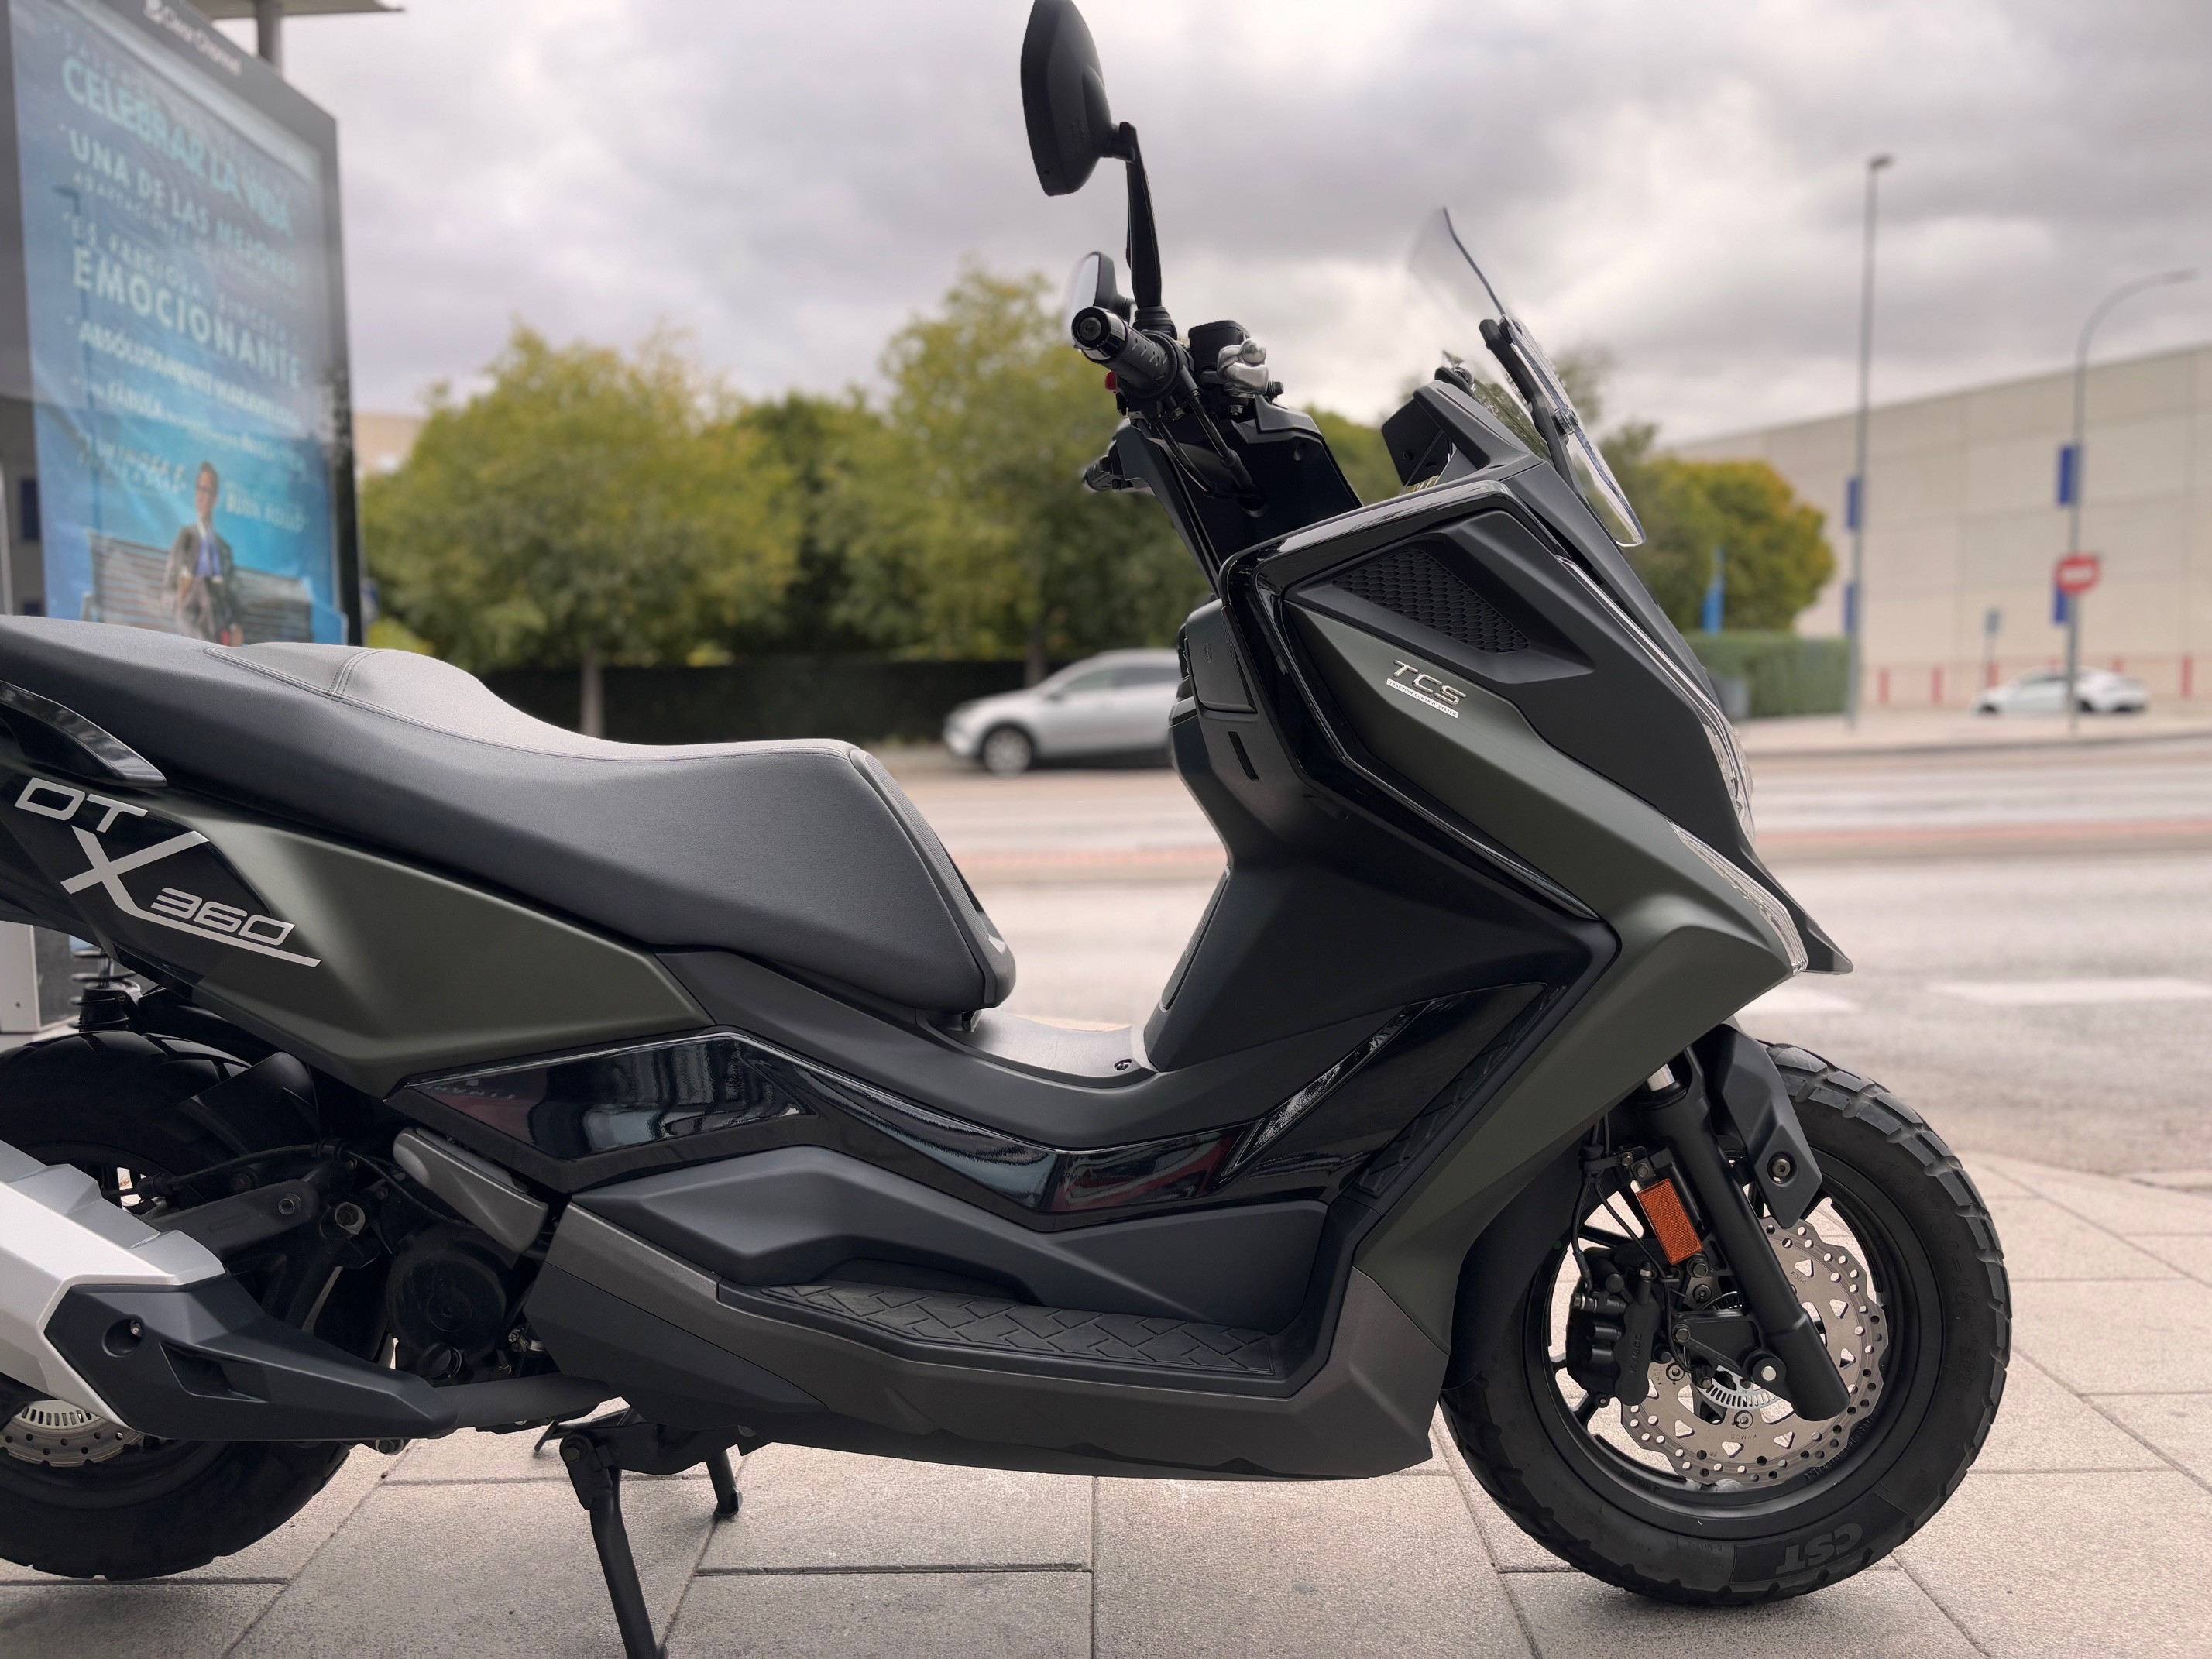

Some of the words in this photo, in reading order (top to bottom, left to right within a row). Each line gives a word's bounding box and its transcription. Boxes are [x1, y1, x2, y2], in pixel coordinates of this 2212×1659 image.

[61, 55, 207, 180] CELEBRAR
[209, 149, 242, 201] LA
[136, 167, 167, 211] DE
[171, 191, 210, 235] LAS
[72, 246, 303, 388] EMOCIONANTE
[1389, 681, 1414, 695] TRACTION
[1414, 692, 1437, 707] CONTROL
[1437, 705, 1457, 717] SYSTEM
[1393, 659, 1467, 706] TCS
[150, 887, 296, 946] 360
[1776, 1523, 1863, 1575] CST
